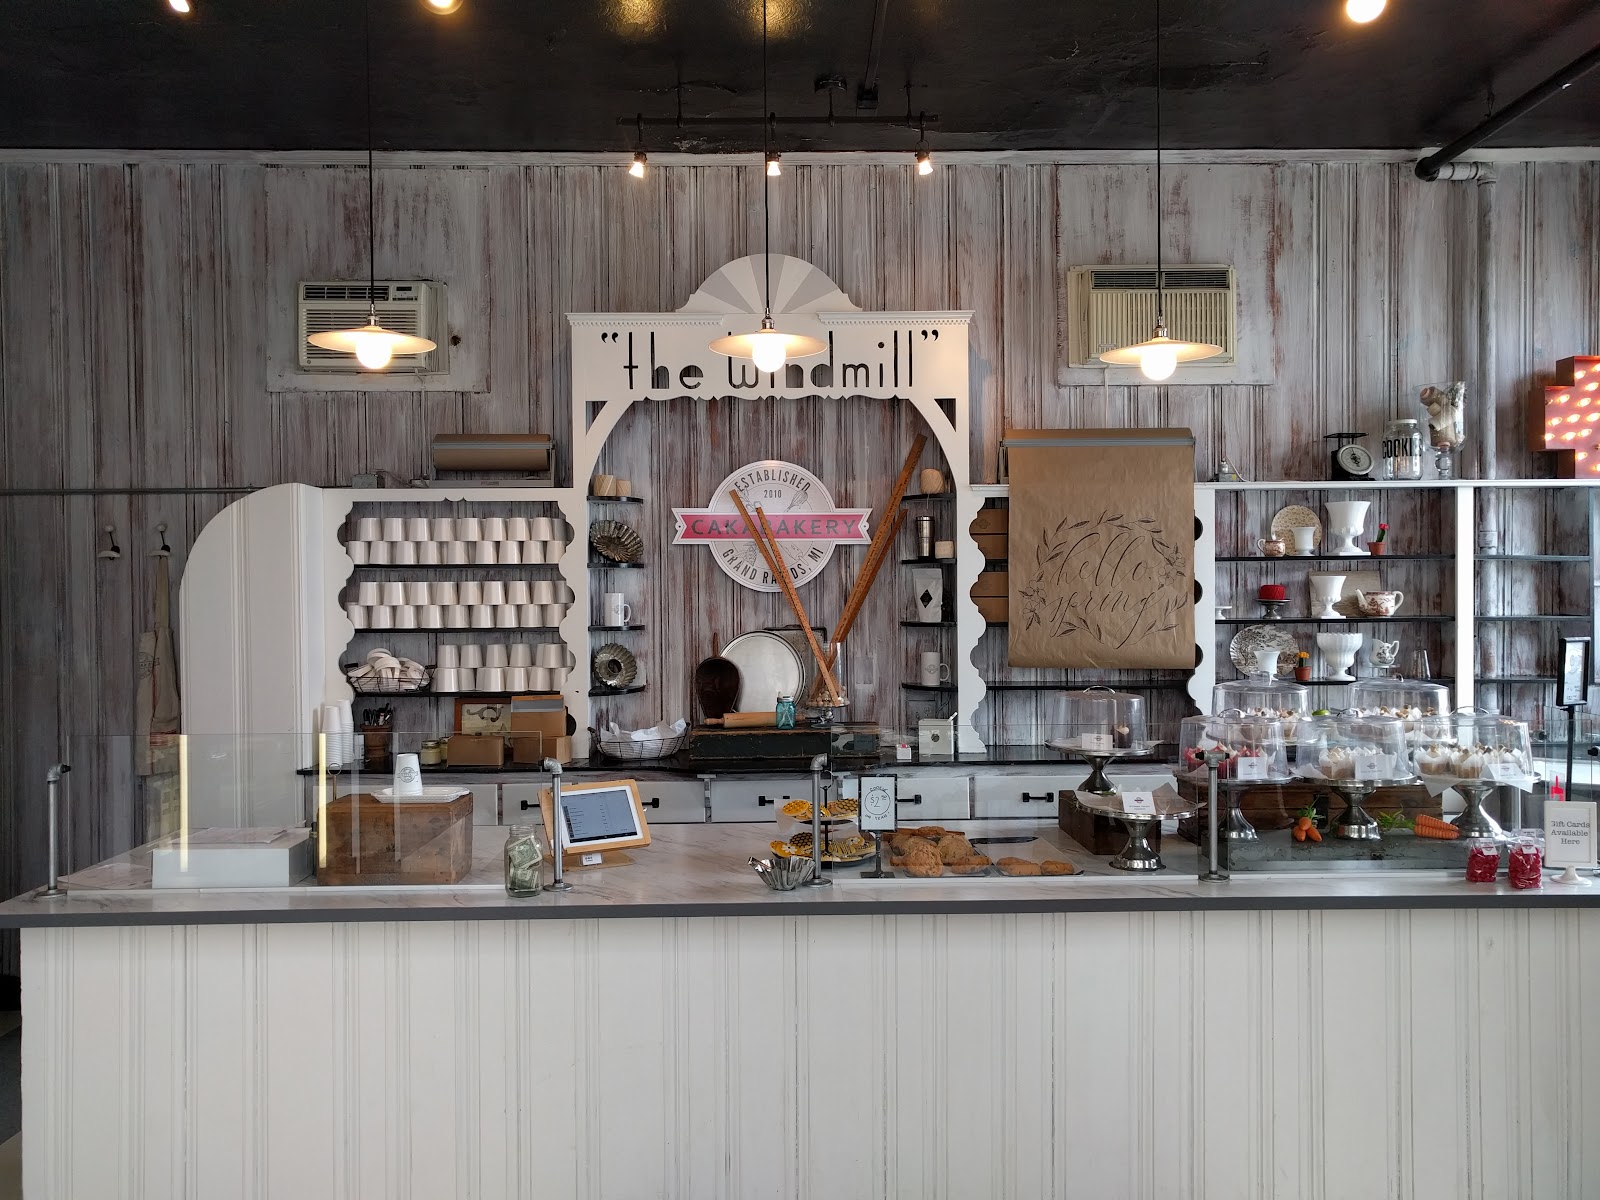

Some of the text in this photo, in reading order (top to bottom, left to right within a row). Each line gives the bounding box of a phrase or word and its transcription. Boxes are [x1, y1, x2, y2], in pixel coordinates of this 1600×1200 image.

[734, 469, 811, 492] ESTABLISHED
[763, 489, 782, 498] 2010
[722, 547, 824, 584] GRAND RADS, MI
[1042, 591, 1161, 650] spring
[1566, 820, 1591, 829] Cards
[1551, 829, 1589, 837] Available
